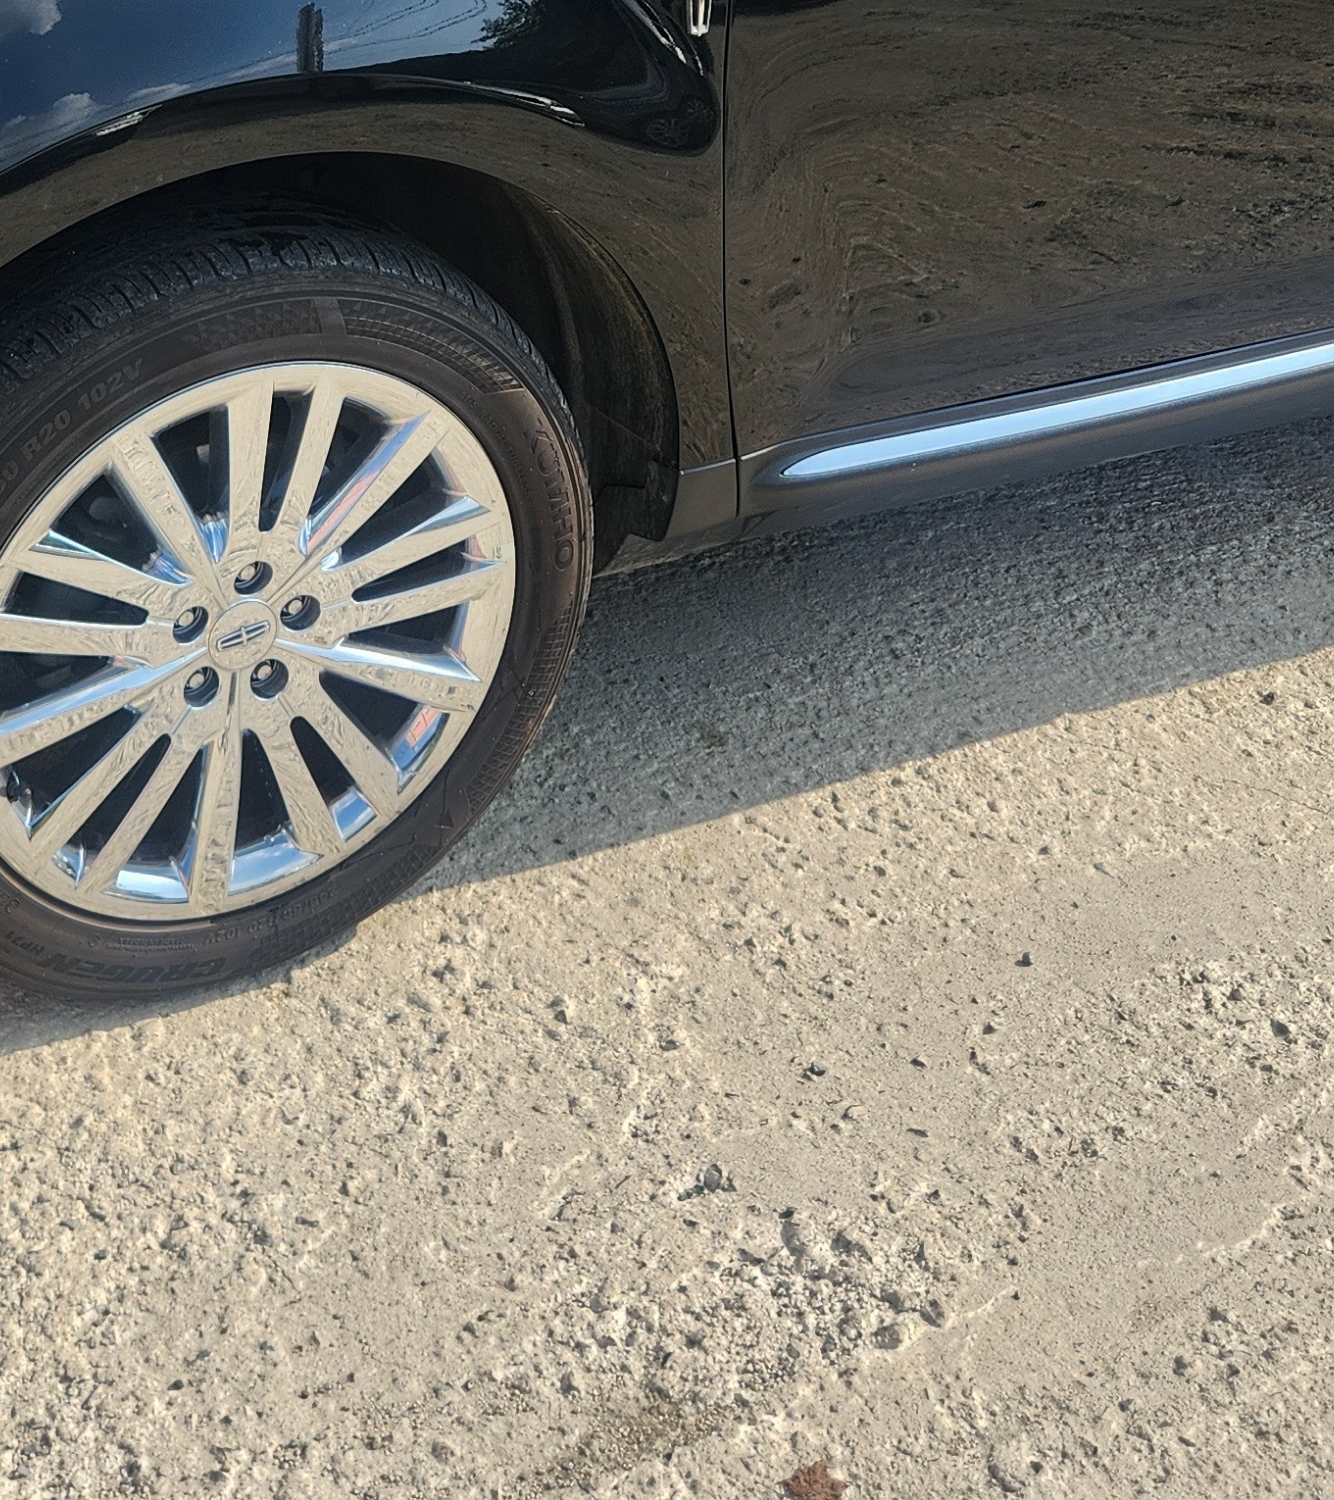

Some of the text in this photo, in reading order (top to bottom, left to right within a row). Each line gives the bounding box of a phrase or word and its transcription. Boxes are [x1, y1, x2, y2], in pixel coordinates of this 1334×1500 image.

[77, 357, 143, 412] 102V
[524, 417, 574, 571] KUMHO
[46, 951, 227, 984] CRUGEN
